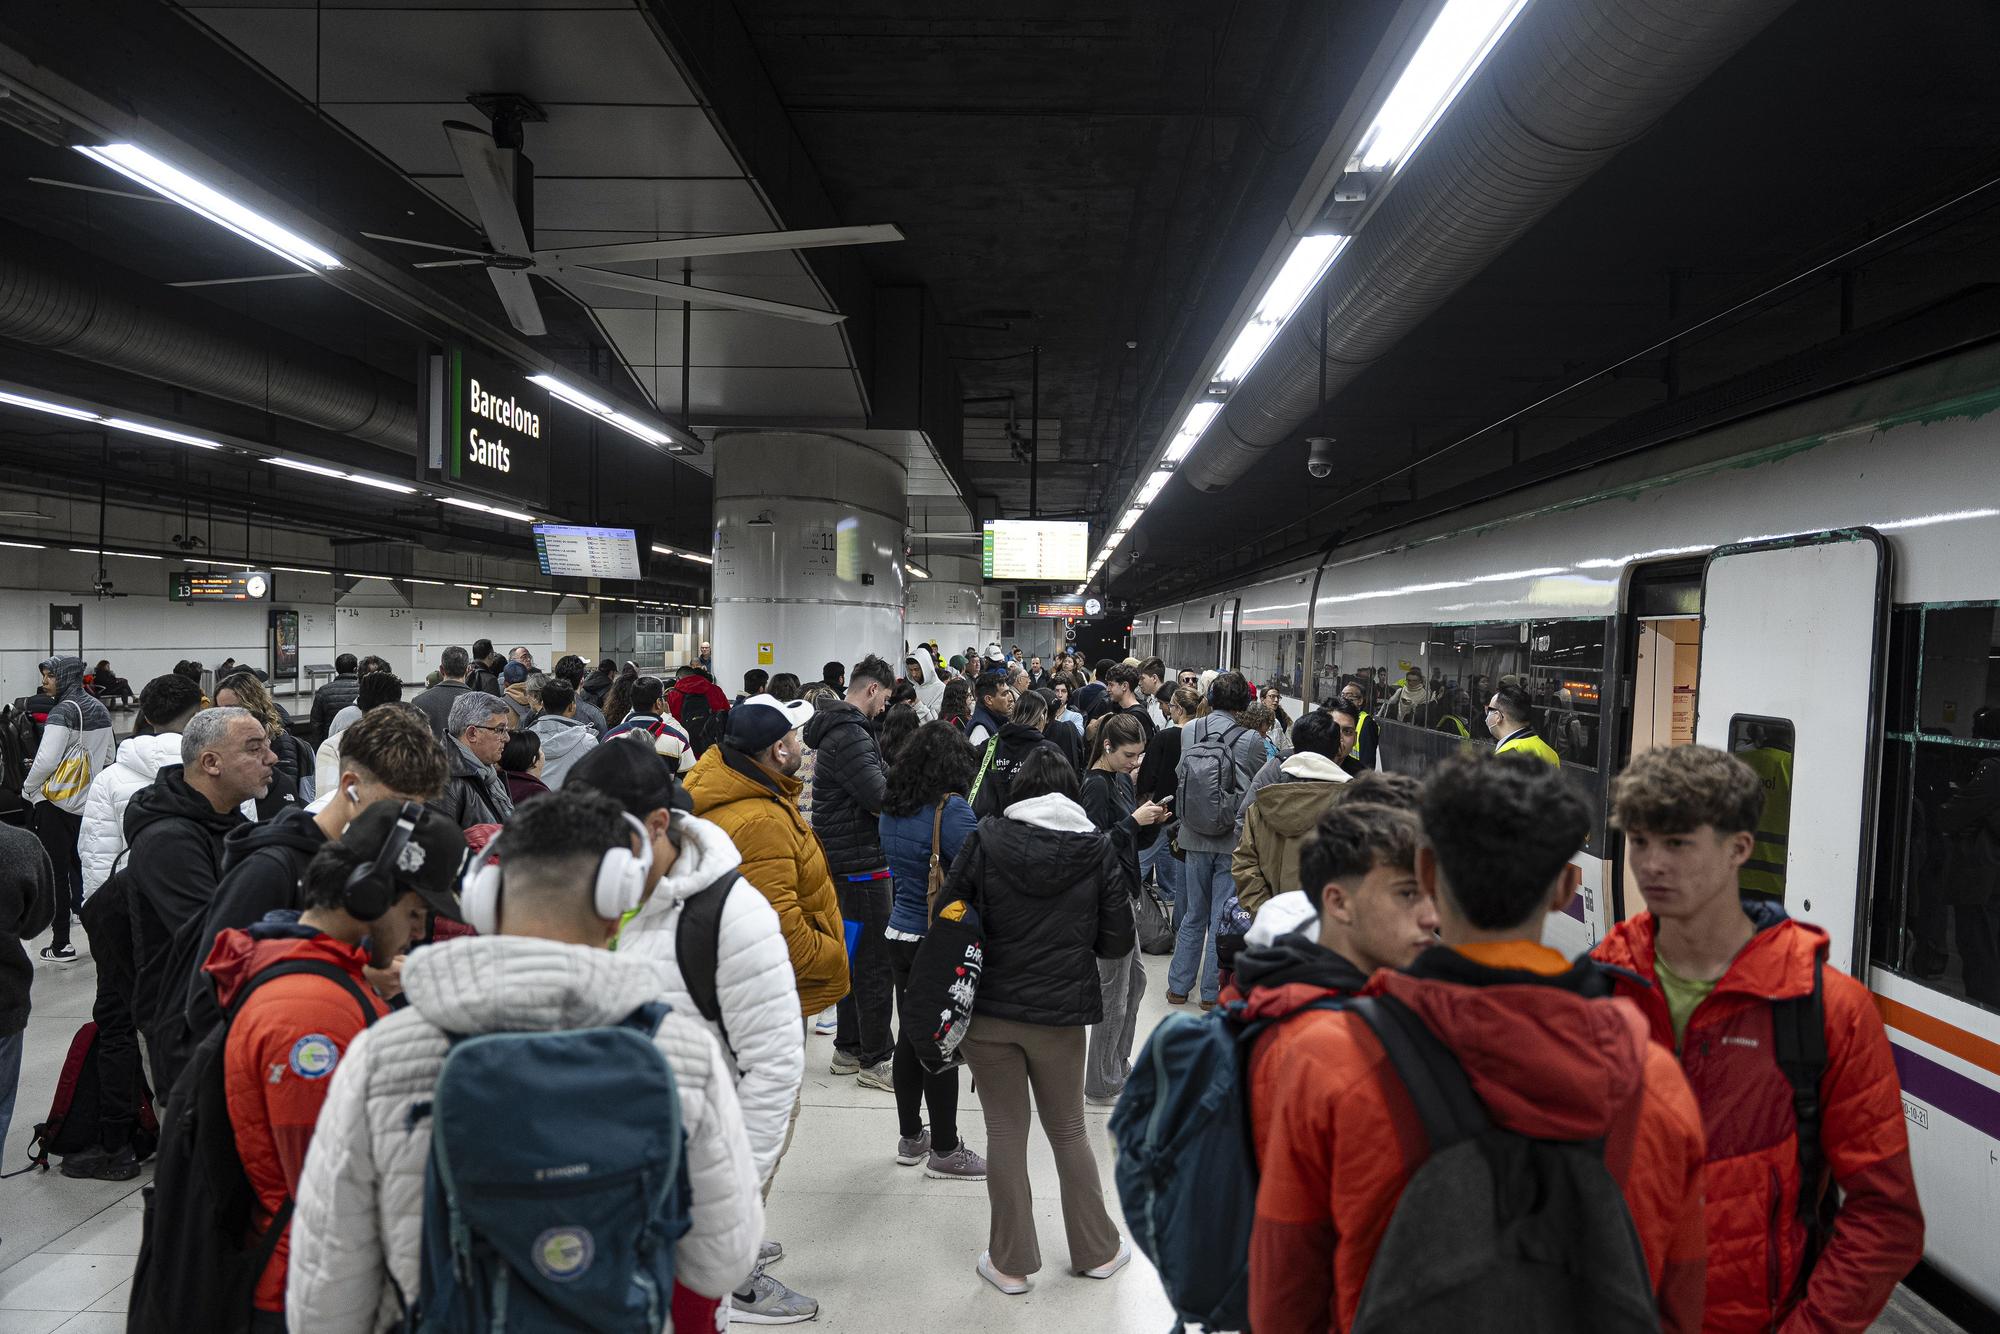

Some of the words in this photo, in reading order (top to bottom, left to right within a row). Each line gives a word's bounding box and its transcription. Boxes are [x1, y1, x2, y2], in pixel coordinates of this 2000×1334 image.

[471, 379, 540, 439] Barcelona
[469, 428, 510, 473] Sants
[821, 533, 835, 551] 11
[178, 586, 191, 597] 13
[348, 608, 359, 617] 14
[390, 609, 400, 618] 13
[1027, 604, 1038, 614] 11
[1903, 1102, 1926, 1125] 0-10-21
